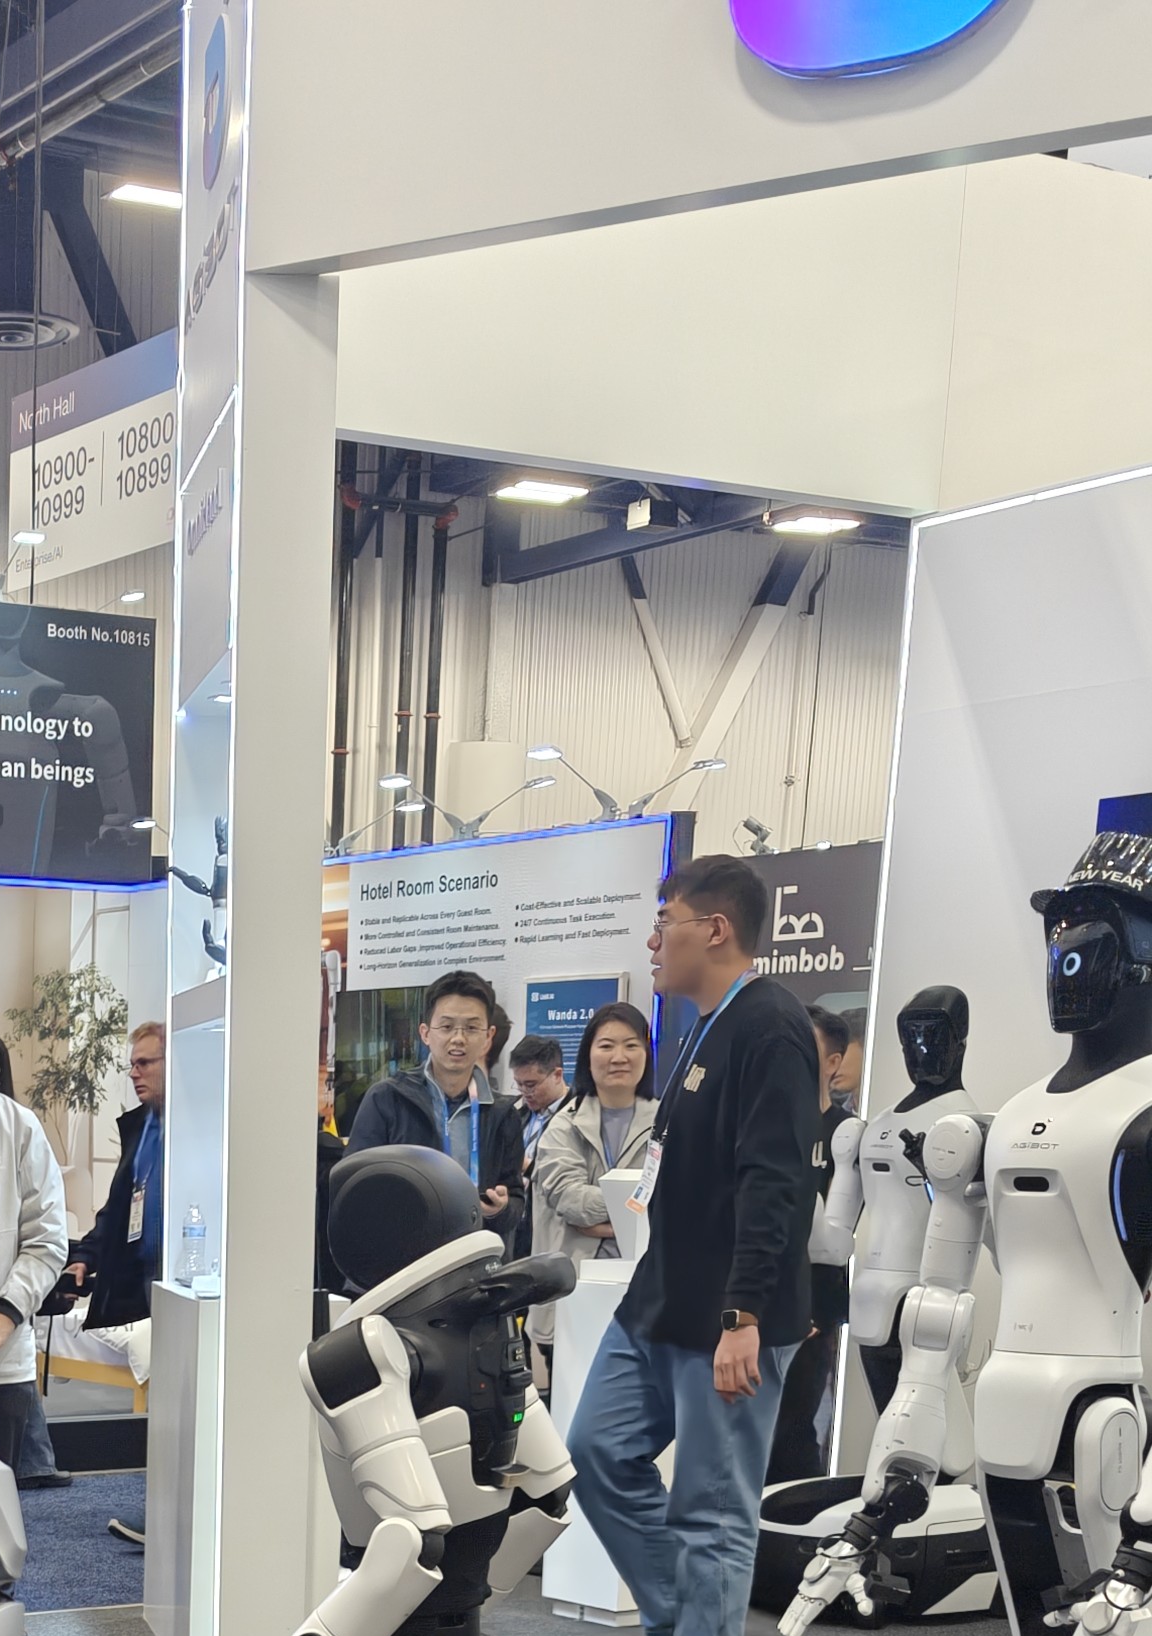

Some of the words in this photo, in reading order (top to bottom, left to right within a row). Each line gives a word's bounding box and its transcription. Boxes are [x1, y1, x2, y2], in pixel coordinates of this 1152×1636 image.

[19, 403, 50, 433] North
[53, 391, 75, 419] Hall
[117, 412, 174, 461] 10800
[116, 452, 172, 499] 10899
[47, 623, 88, 640] Booth
[91, 626, 151, 647] No.10815
[73, 717, 94, 738] to
[30, 757, 94, 788] beings
[360, 881, 393, 901] Hotel
[396, 879, 434, 898] Room
[439, 870, 498, 894] Scenario
[1101, 870, 1144, 891] YEAR
[547, 1008, 578, 1021] Wanda
